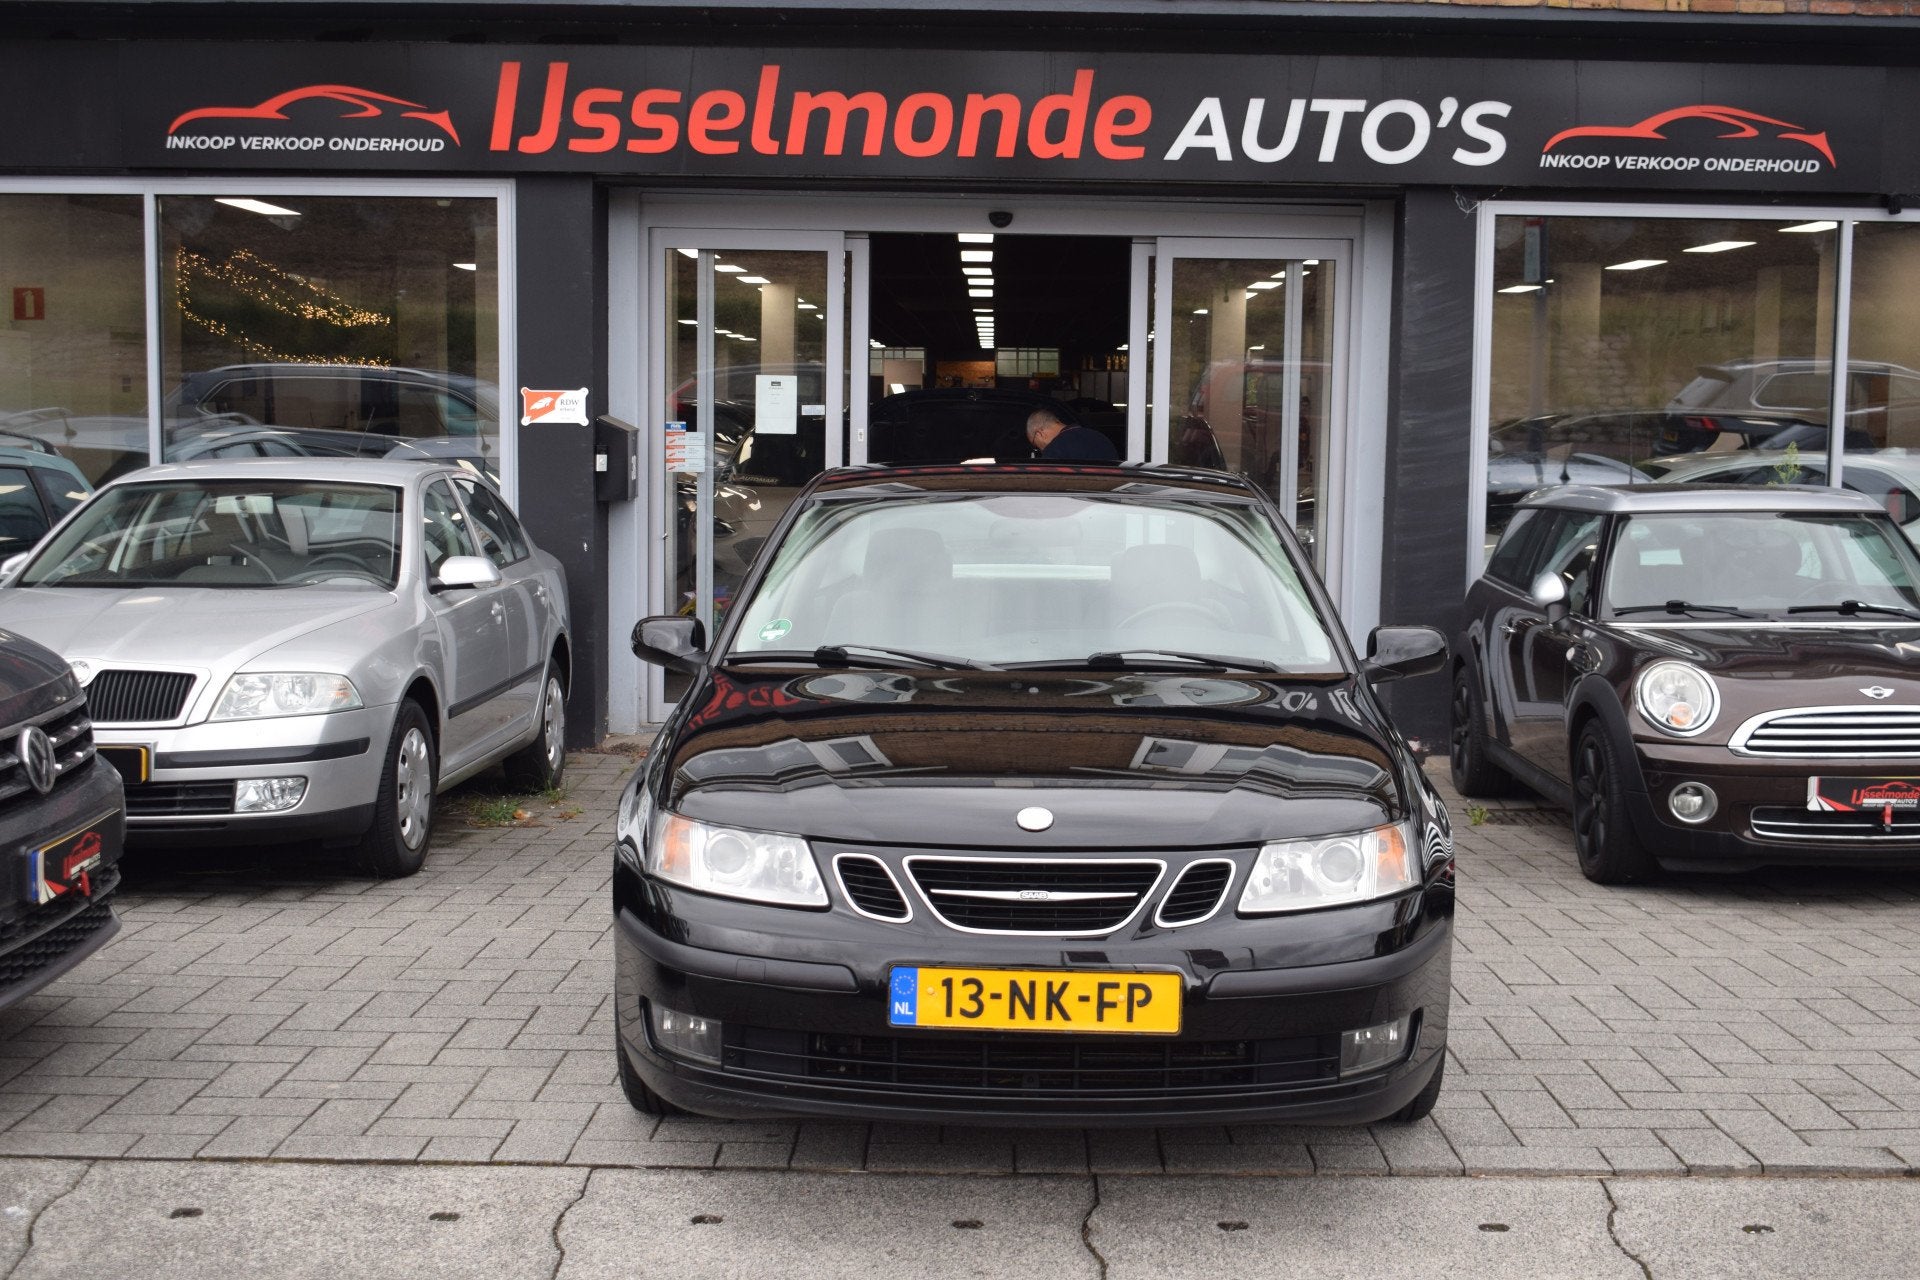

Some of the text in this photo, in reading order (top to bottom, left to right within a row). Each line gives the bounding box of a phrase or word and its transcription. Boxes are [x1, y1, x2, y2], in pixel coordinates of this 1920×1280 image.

[489, 61, 1513, 167] IJsselmonde AUTO'S
[165, 135, 445, 153] INKOOP VERKOOP ONDERHOUD
[1539, 154, 1820, 173] INKOOP VERKOOP ONDERHOUD
[1022, 891, 1047, 899] SAAB
[894, 1001, 913, 1015] NL
[941, 976, 1153, 1022] 13-NK-FP
